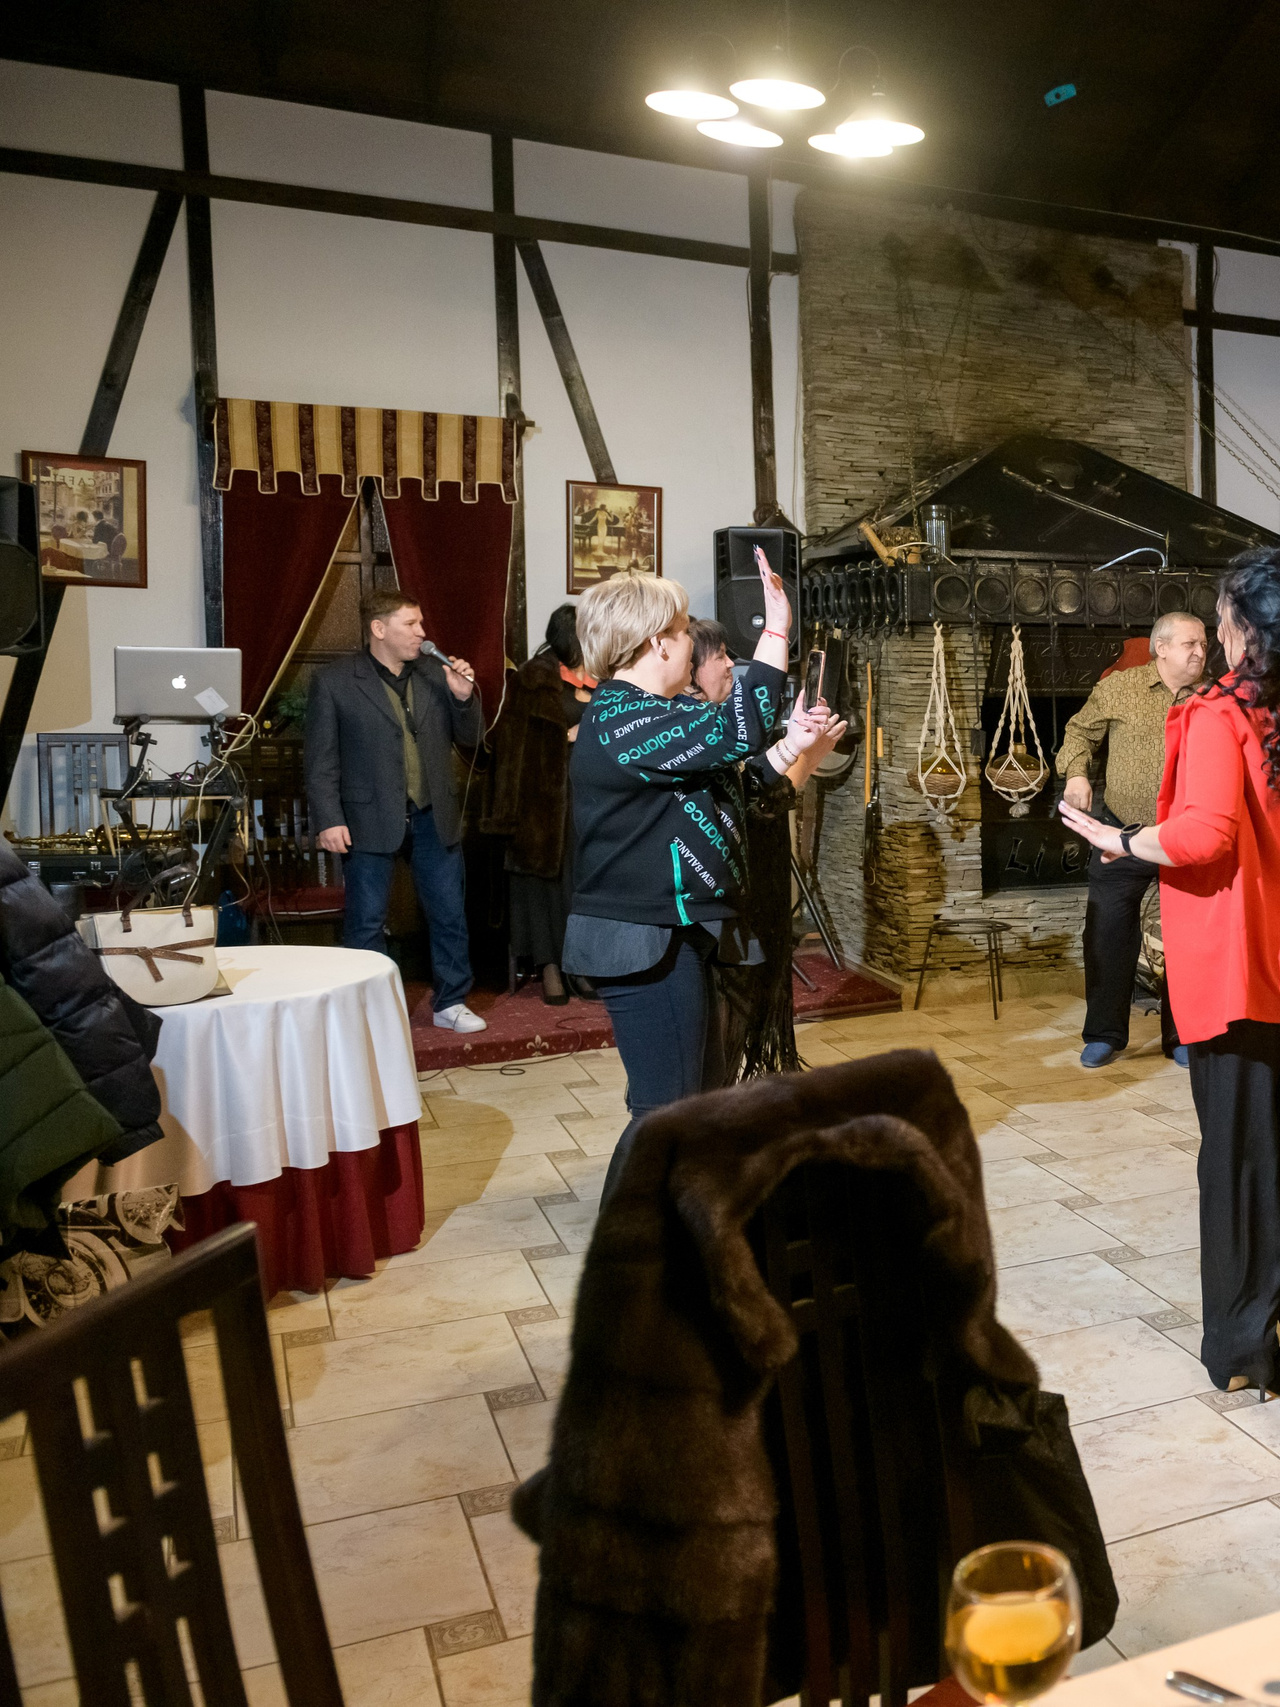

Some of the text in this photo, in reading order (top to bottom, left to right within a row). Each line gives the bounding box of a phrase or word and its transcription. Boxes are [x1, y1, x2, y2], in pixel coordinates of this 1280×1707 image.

[613, 716, 652, 739] BALANCE
[734, 696, 748, 741] BALANCE
[618, 725, 686, 765] balance
[685, 742, 705, 759] NEW
[683, 801, 730, 862] balance
[672, 836, 718, 890] NEW BALANCE
